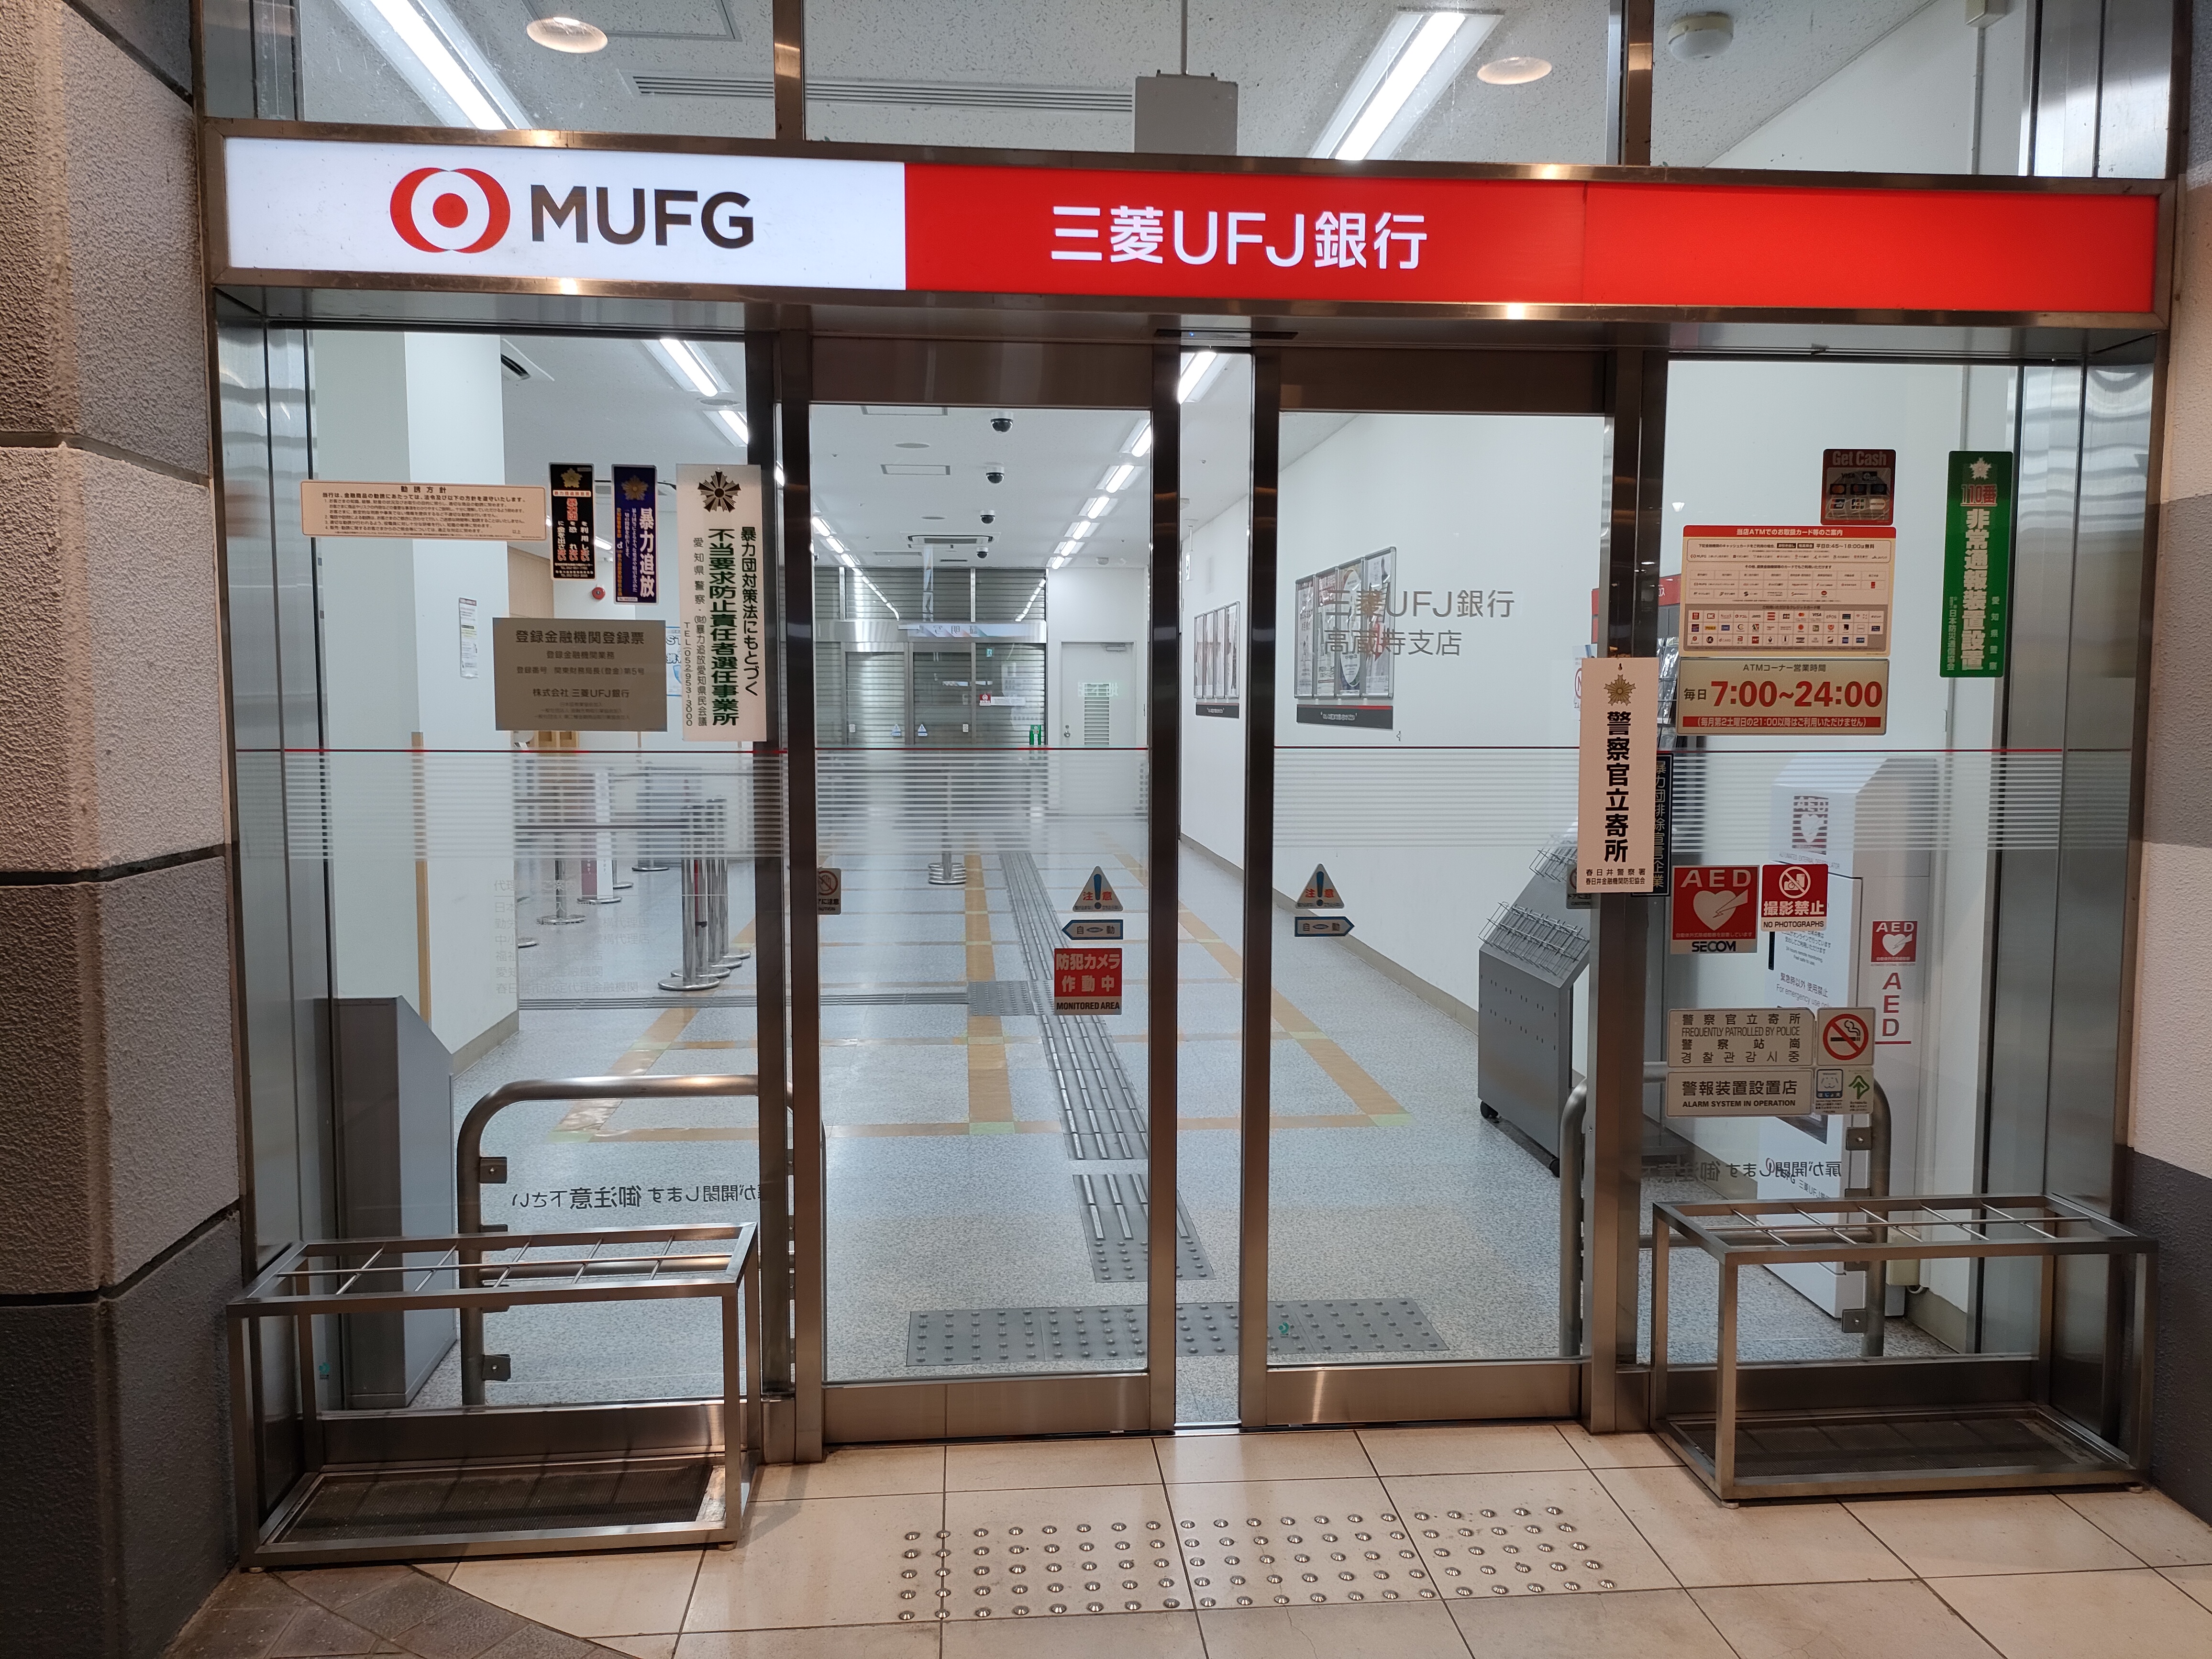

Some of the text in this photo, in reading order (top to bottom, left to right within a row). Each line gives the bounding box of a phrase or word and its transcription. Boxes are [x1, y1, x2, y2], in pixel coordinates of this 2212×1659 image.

[531, 184, 754, 249] MUFG
[1051, 205, 1427, 269] 三菱UFJ銀行
[1832, 451, 1887, 466] Get Cash
[401, 486, 447, 494] 勧誘方針
[1961, 484, 1998, 504] 110番
[639, 507, 655, 597] 暴力追放
[1961, 509, 1990, 671] 非常通報装置設置
[1325, 589, 1515, 619] 三菱UFJ銀行
[741, 527, 759, 697] 暴力団対策法にもとづく
[708, 528, 740, 726] 不当要求防止責任者選任事業所
[516, 630, 645, 645] 登録金融機関登録票
[1324, 629, 1462, 657] 高蔵寺支店
[546, 650, 615, 660] 登録金融機関業務
[517, 666, 547, 675] 登録番号
[1743, 664, 1826, 672] ATMコーナー営業時間
[532, 688, 630, 698] 株式会社 三菱UFJ銀行
[1683, 688, 1707, 701] 毎日
[1697, 717, 1867, 727] (毎月第2土曜日の21:00以降はご利用いただけません)
[1604, 711, 1632, 863] 警察官立寄所
[1652, 760, 1667, 888] 暴力団排除宣言企業
[1586, 868, 1646, 876] 春日井警察署
[1681, 869, 1752, 888] AED
[1586, 877, 1646, 885] 春日井金融機関防犯協会
[1083, 891, 1112, 901] 注意
[1305, 888, 1334, 898] 注意
[1763, 900, 1825, 916] 撮影禁止
[1077, 925, 1115, 935] 自動
[1875, 922, 1914, 932] AED
[1692, 940, 1736, 952] SECOM
[1056, 953, 1120, 970] 防犯カメラ
[1062, 975, 1115, 993] 作動中
[1781, 972, 1828, 998] 緊急時以外 使用禁止
[1776, 984, 1784, 993] For
[1785, 987, 1811, 1005] emergency
[1811, 999, 1820, 1007] use
[1056, 1002, 1099, 1010] MONITORED
[1682, 1013, 1801, 1026] 警察官立寄所
[1682, 1026, 1801, 1037] FREQUENTLY PATROLLED BY POLICE
[1682, 1080, 1797, 1096] 警報装置設置店
